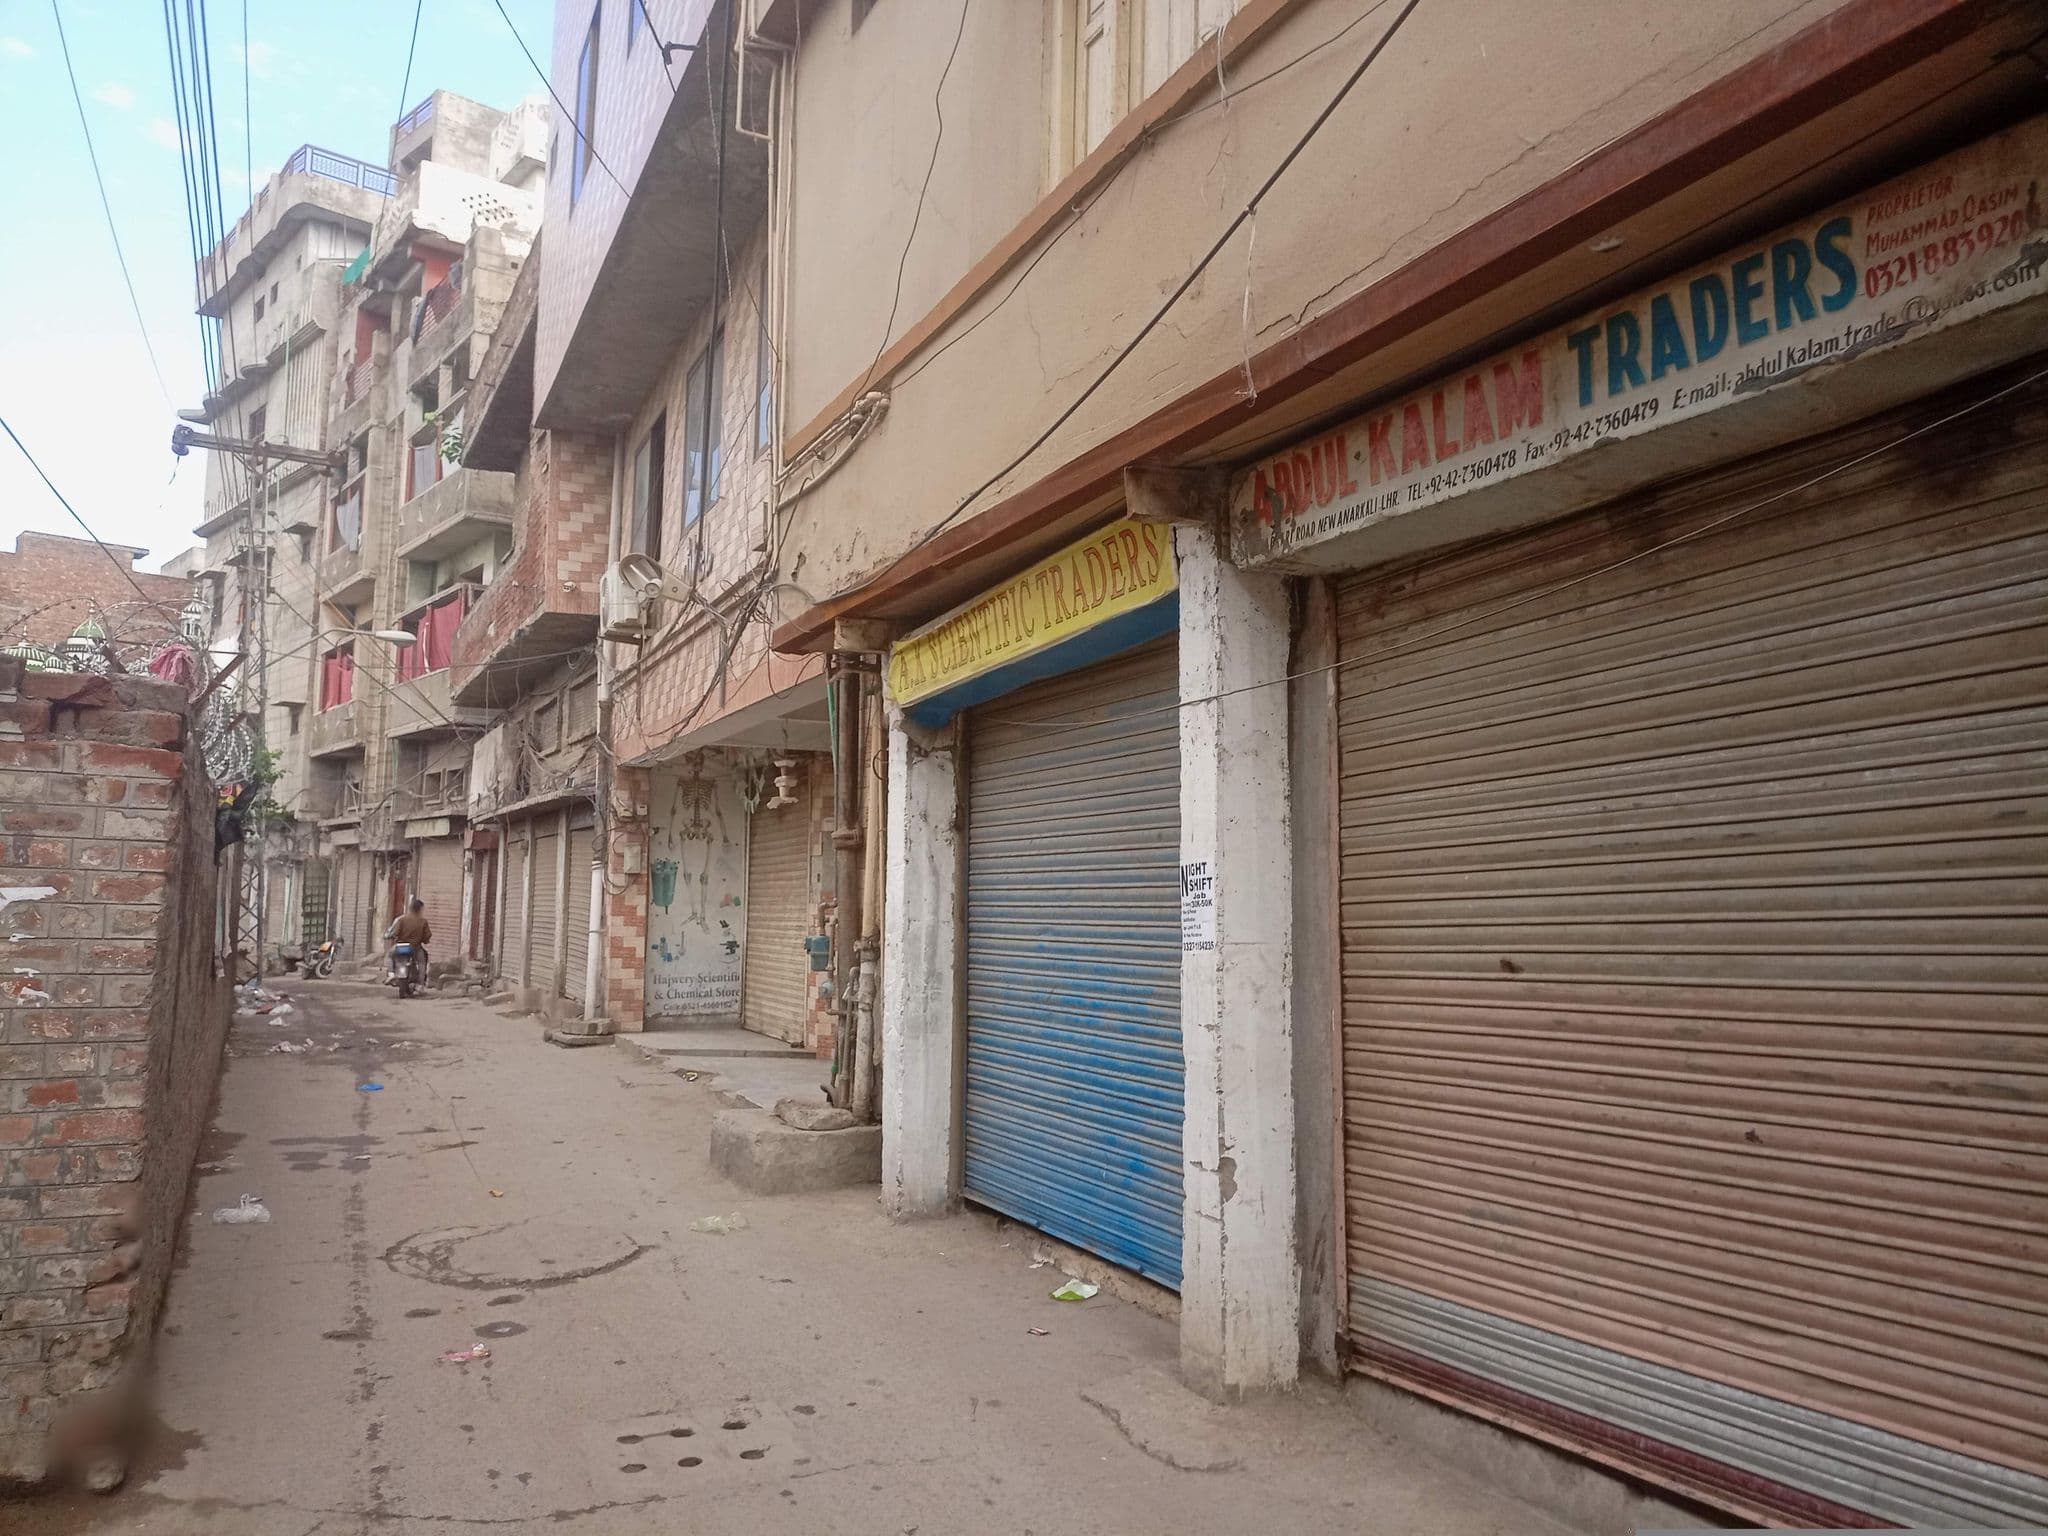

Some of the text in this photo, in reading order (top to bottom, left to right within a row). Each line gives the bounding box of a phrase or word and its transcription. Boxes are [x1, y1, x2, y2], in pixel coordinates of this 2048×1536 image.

[1866, 174, 1953, 228] PROPRIETOR
[1866, 184, 2019, 257] MUHAMMAD QASIM
[1253, 217, 1857, 527] ABDUL KALAM TRADERS
[1295, 522, 1316, 542] ROAD
[1317, 512, 1337, 537] NEW
[1337, 497, 1378, 528] ANARKALI
[928, 577, 1035, 679] SCIENTIFIC
[1035, 522, 1161, 630] TRADERS
[1181, 862, 1207, 897] NIGHT
[1189, 877, 1213, 892] SHIFT
[654, 990, 664, 1000] &
[666, 987, 713, 999] Chemical
